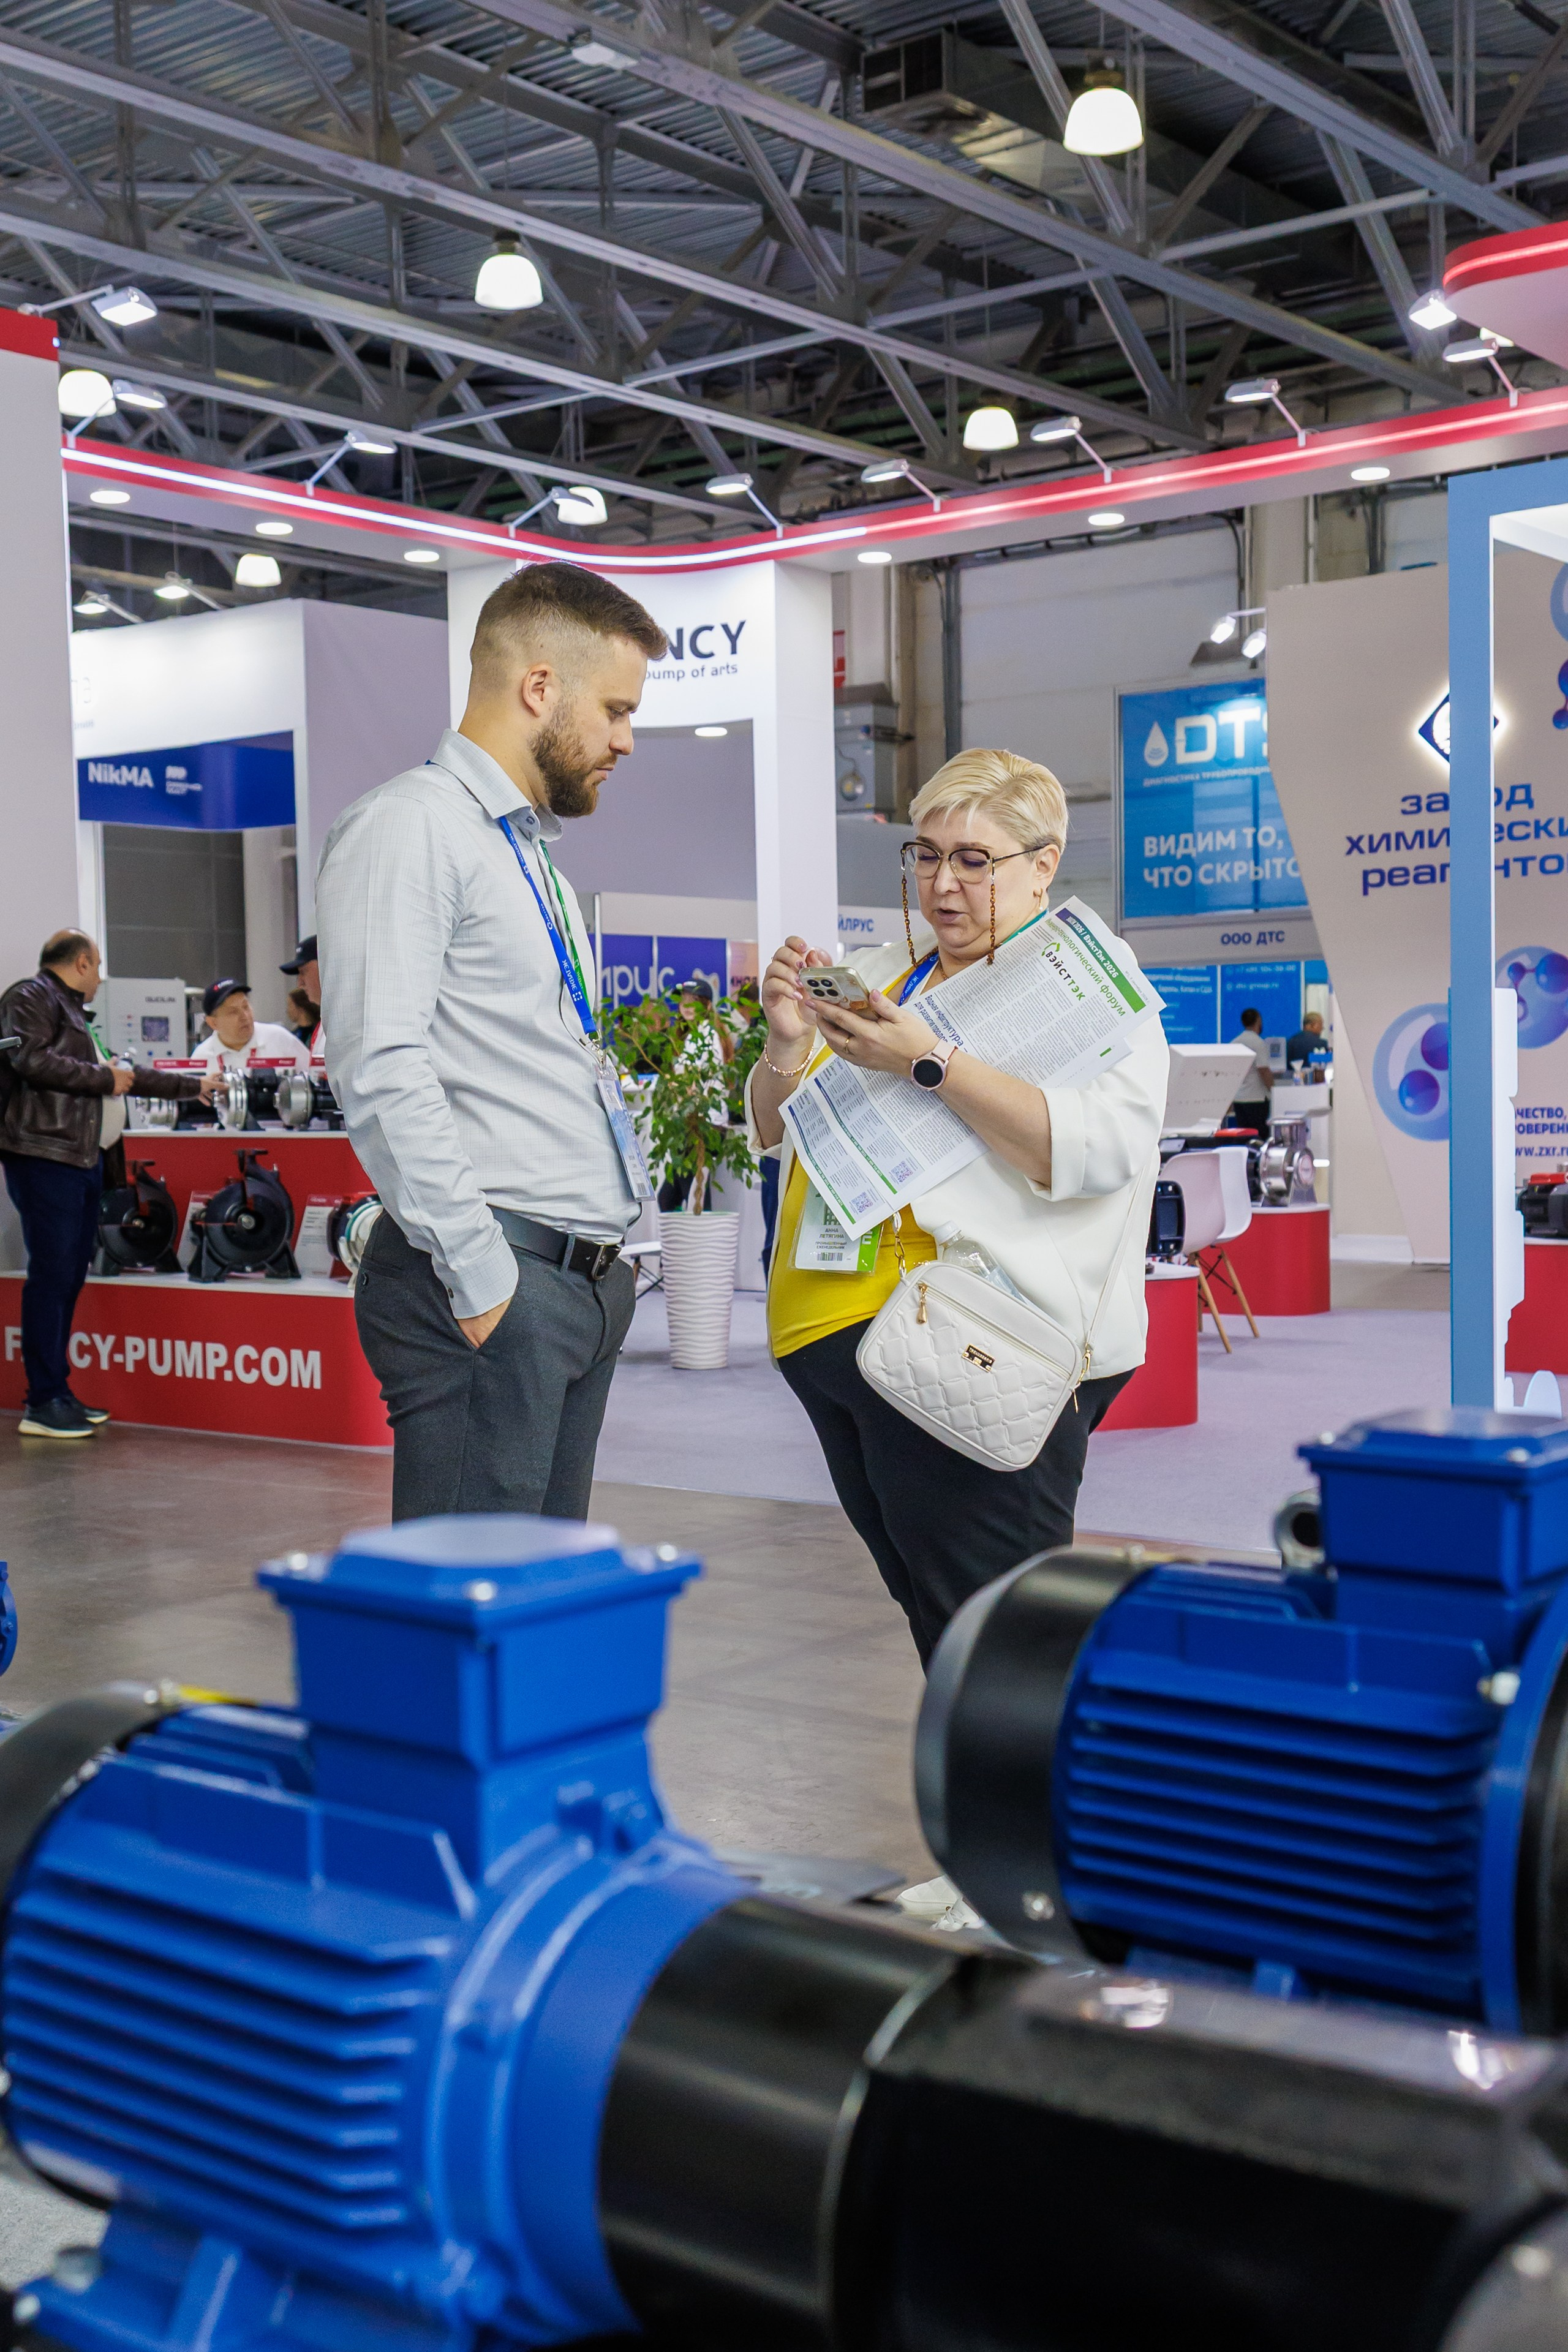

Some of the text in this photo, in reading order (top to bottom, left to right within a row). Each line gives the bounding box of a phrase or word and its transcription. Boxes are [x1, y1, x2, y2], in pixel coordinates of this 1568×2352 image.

[691, 666, 704, 678] of
[710, 663, 738, 677] arts
[1175, 706, 1267, 764] DT
[88, 761, 154, 788] NikMA
[1401, 783, 1534, 815] зад
[1144, 826, 1284, 859] ВИДИМ ТО,
[1346, 816, 1568, 856] химиск
[1144, 864, 1193, 888] ЧТО
[1362, 854, 1568, 897] реагнто
[1221, 930, 1285, 945] ООО ДТС
[1082, 933, 1107, 963] ВэйстТэк
[1102, 959, 1119, 979] 2026
[561, 959, 578, 991] ЭКВАТЭК
[1045, 950, 1086, 1001] ВЭЙСТТЭК
[1098, 984, 1126, 1017] форум
[924, 993, 938, 1012] Водная
[934, 1009, 965, 1047] инфраструктура
[1515, 1107, 1567, 1120] ЧЕСТВО,
[1515, 1123, 1568, 1134] ОВЕРЕН
[1515, 1147, 1568, 1156] ww.zxr.r
[4, 1326, 322, 1389] FCY-PUMP.COM
